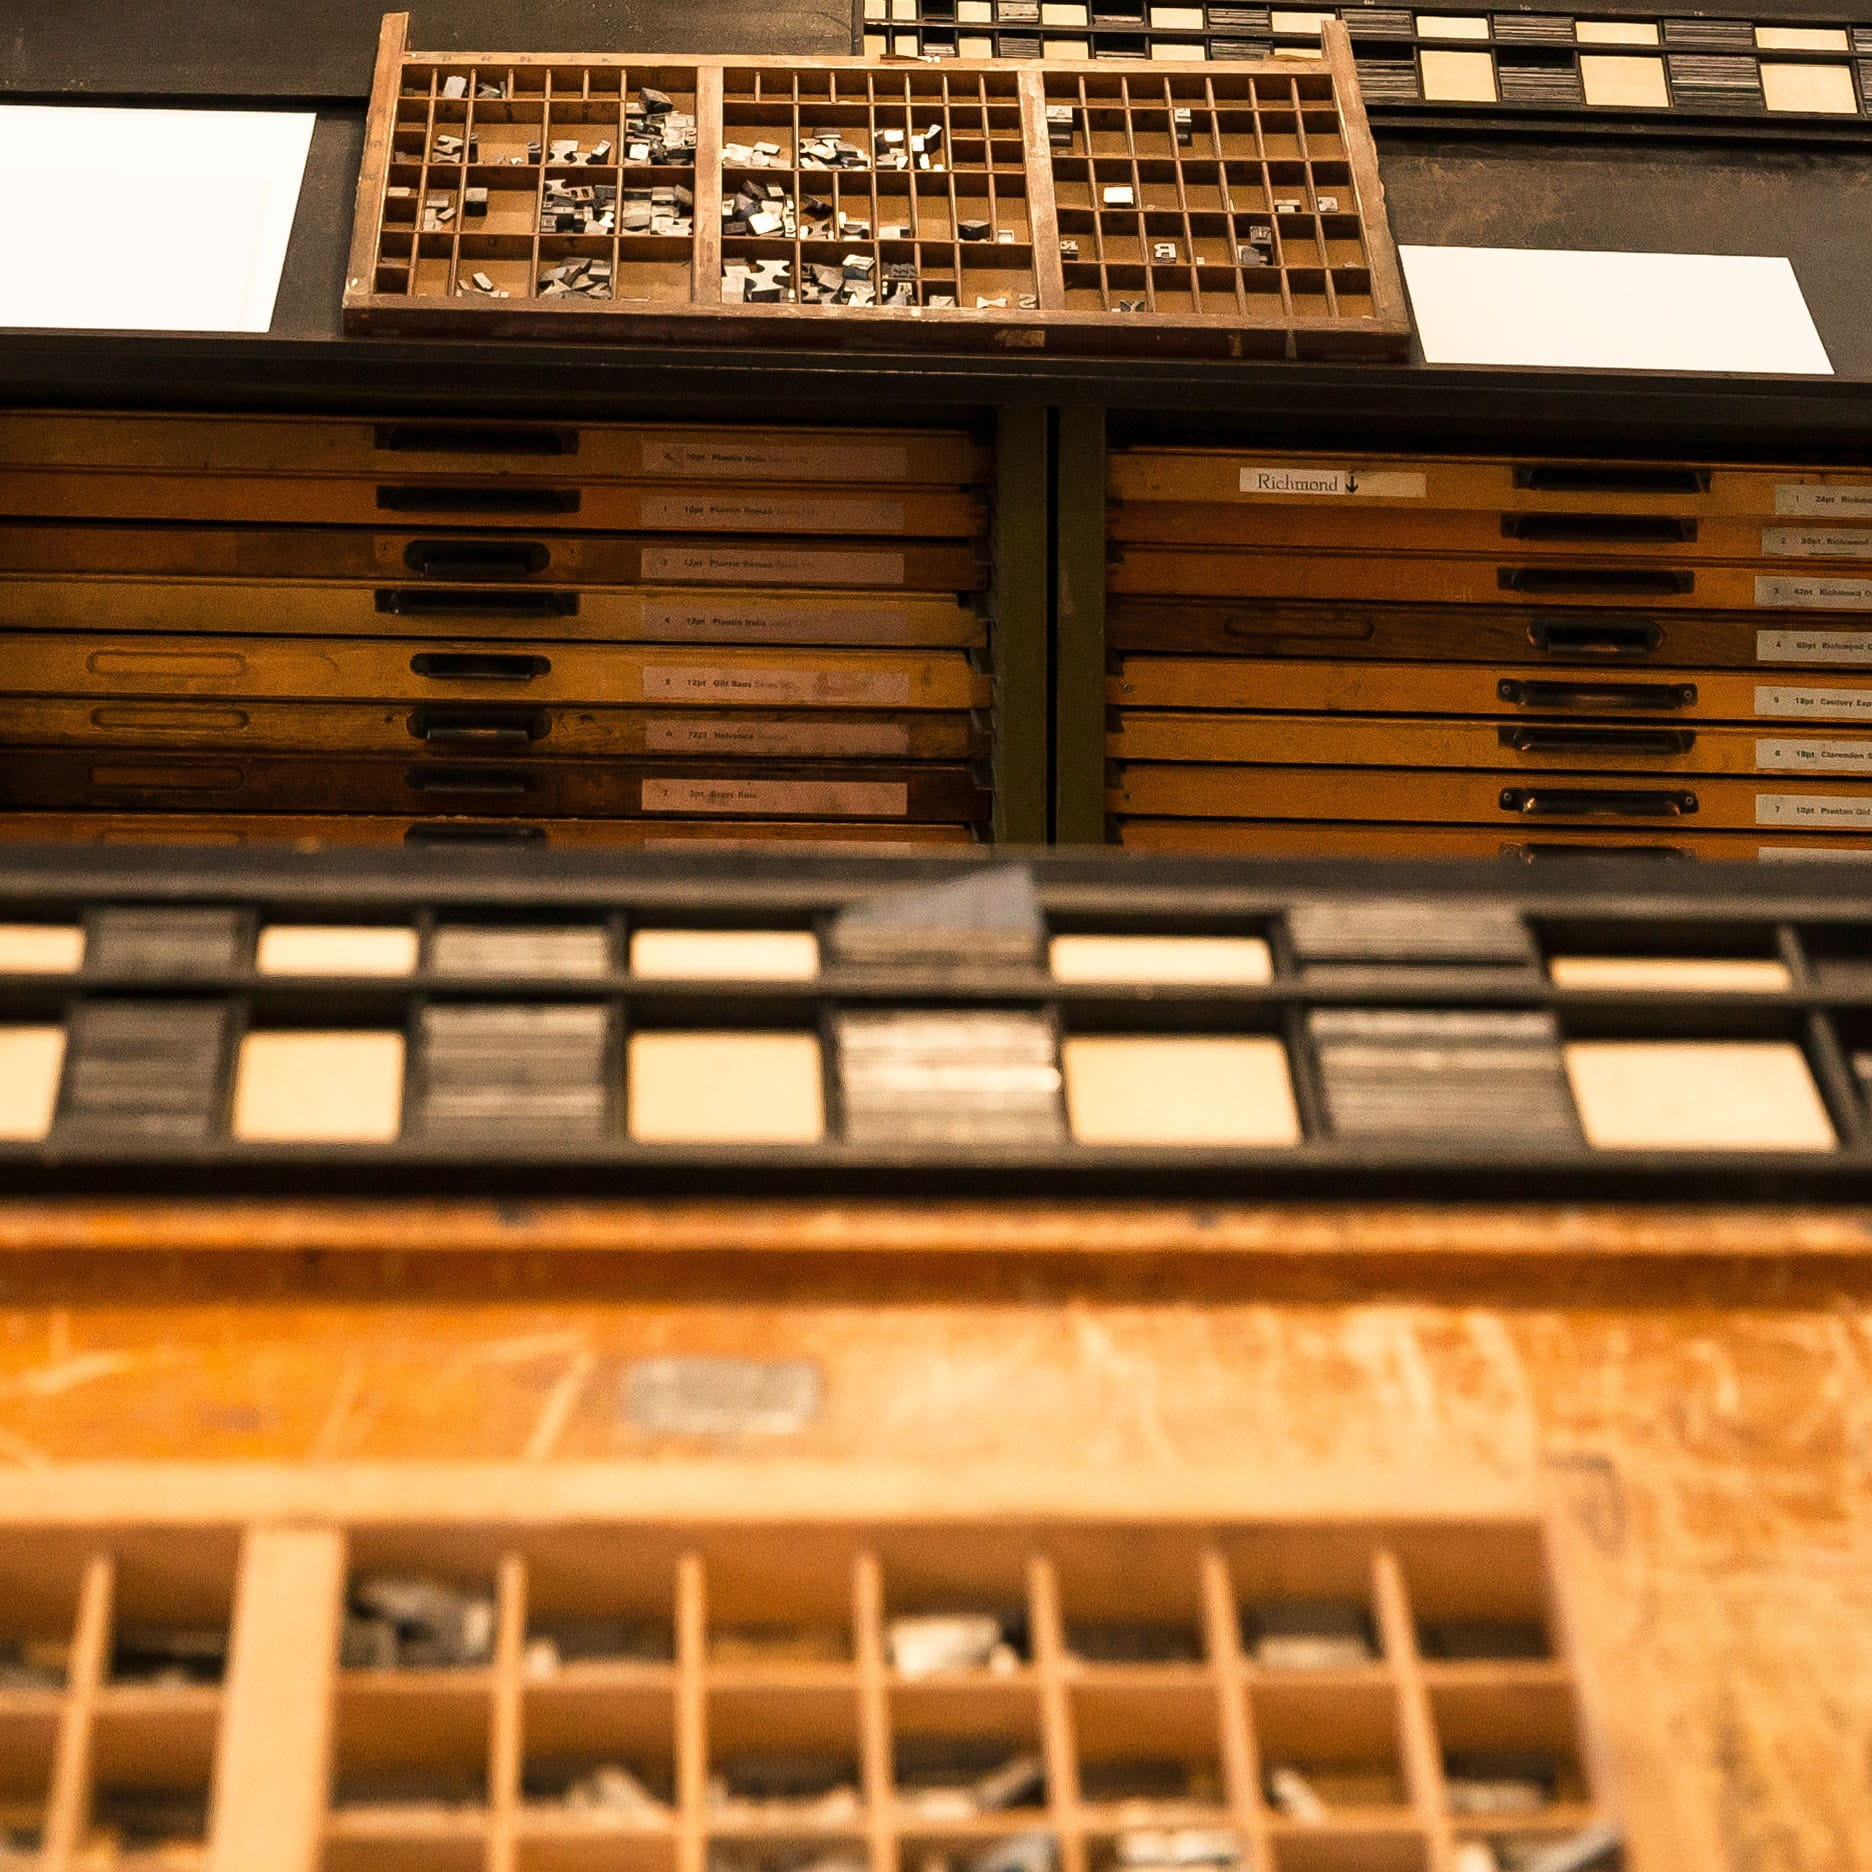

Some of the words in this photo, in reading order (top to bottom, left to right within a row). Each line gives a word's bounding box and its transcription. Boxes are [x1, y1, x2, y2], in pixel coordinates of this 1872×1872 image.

[1256, 470, 1339, 495] Richmond
[1826, 537, 1869, 547] Richmond
[1819, 588, 1862, 598] Richmond
[1822, 642, 1865, 652] Richmond
[1820, 698, 1853, 708] Century
[1821, 751, 1865, 760] Clarendon
